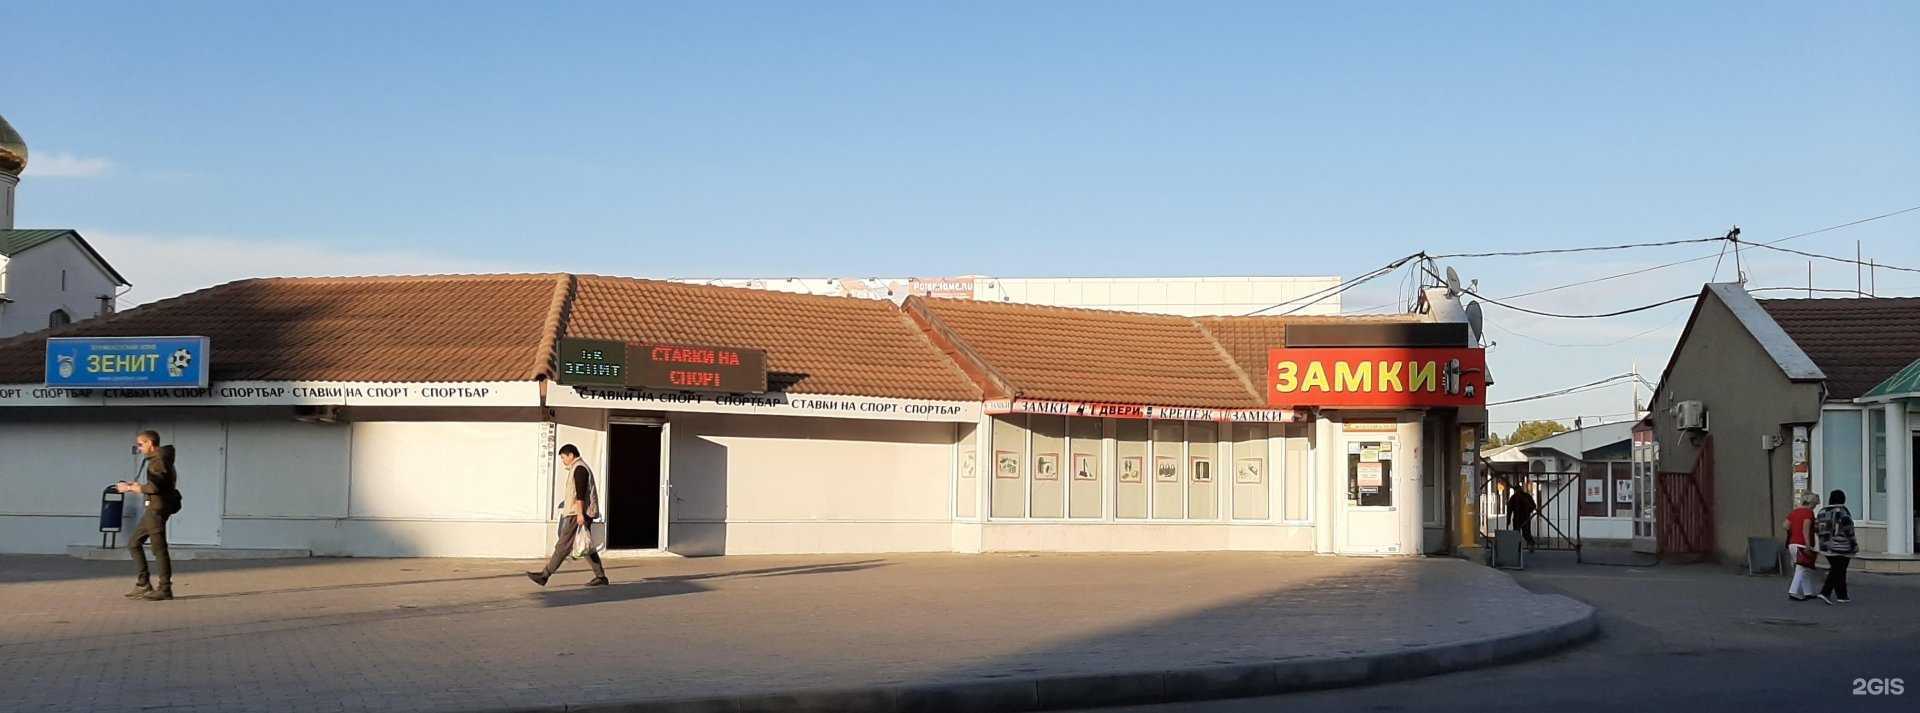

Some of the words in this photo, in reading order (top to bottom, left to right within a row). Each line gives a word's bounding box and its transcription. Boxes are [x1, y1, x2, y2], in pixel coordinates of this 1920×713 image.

[87, 354, 160, 373] ЗЕНИТ
[652, 347, 714, 365] СТАВКИ
[718, 351, 740, 366] НА
[1276, 360, 1436, 393] ЗАМКИ
[32, 388, 92, 399] СПОРТБАР
[104, 388, 149, 399] СТАВКИ
[152, 388, 169, 398] НА
[174, 387, 213, 399] СПОРТ
[220, 387, 285, 398] СПОРТБАР
[292, 387, 342, 398] СТАВКИ
[346, 387, 363, 398] НА
[366, 387, 408, 398] СПОРТ
[421, 387, 489, 398] СПОРТБАР
[579, 388, 636, 402] СТАВКИ
[639, 391, 654, 402] НА
[659, 393, 702, 404] СПОРТ
[715, 395, 781, 408] СПОРТБАР
[791, 398, 838, 411] СТАВКИ
[841, 401, 856, 412] НА
[860, 402, 897, 413] СПОРТ
[904, 405, 961, 415] СПОРТБАР
[1021, 401, 1069, 414] ЗАМКИ
[1099, 405, 1141, 416] ДВЕРИ
[1159, 408, 1213, 421] КРЕПЕЖ
[1231, 409, 1282, 422] ЗАМКИ
